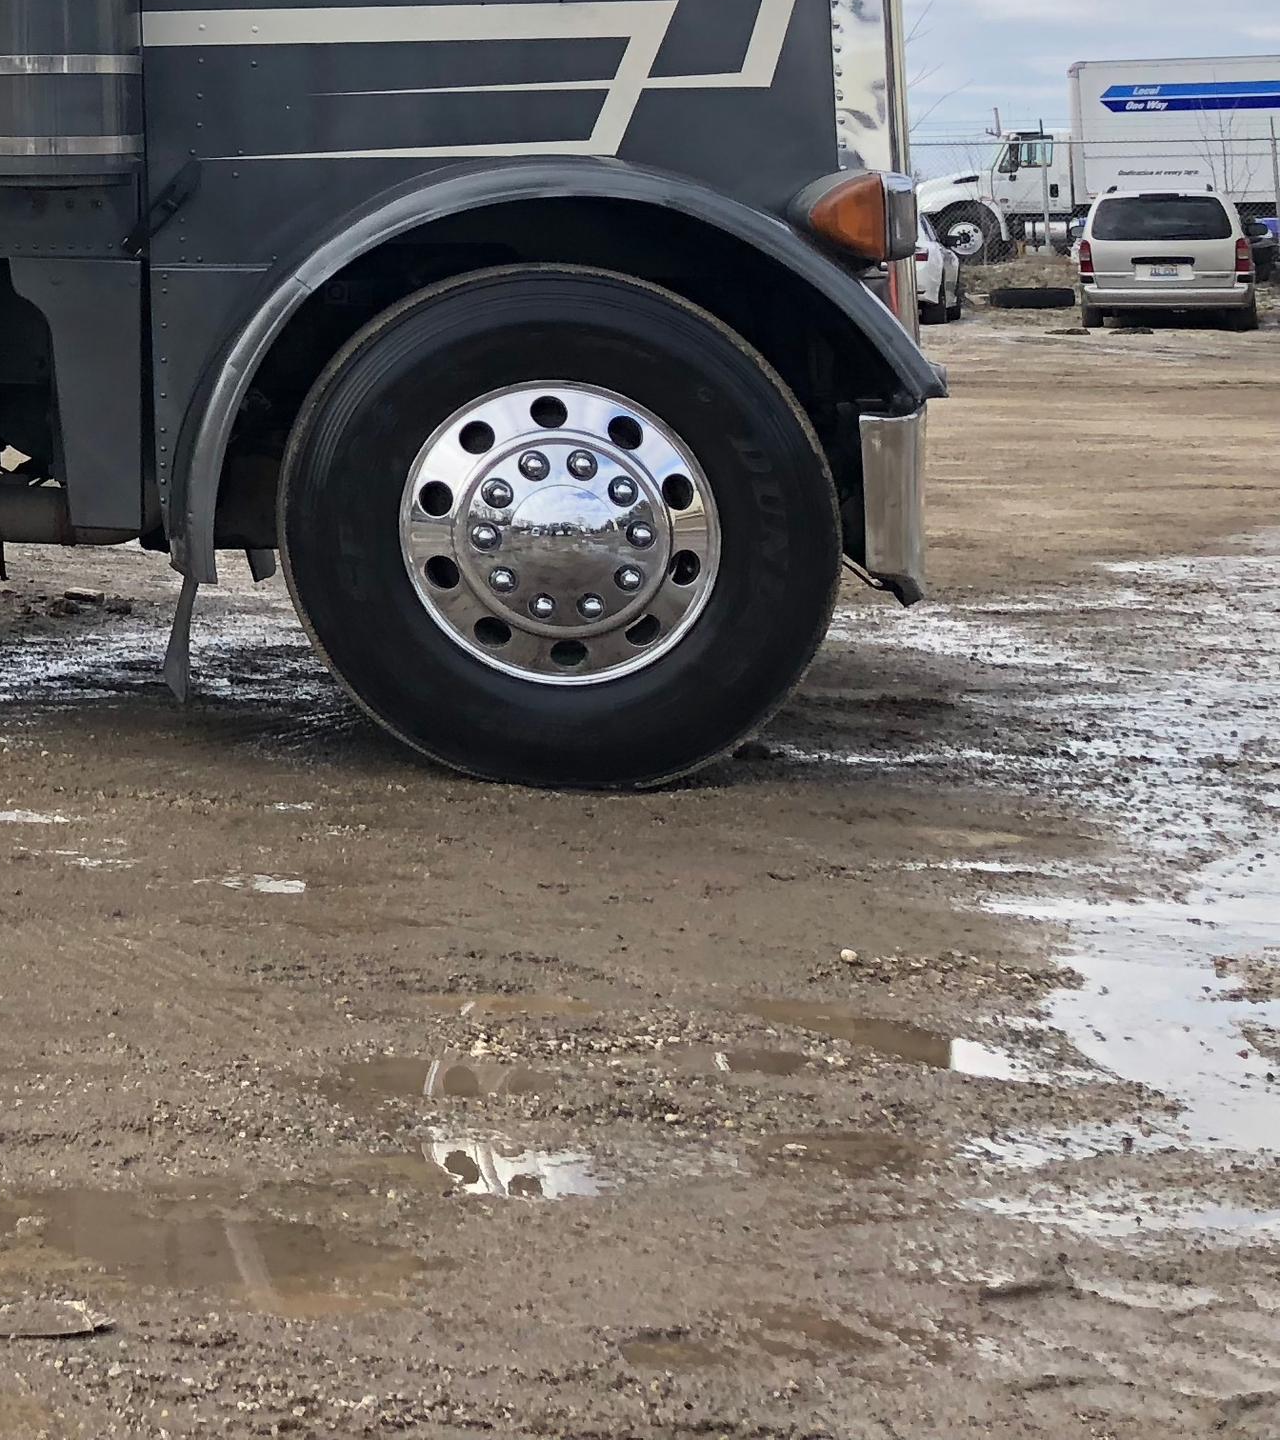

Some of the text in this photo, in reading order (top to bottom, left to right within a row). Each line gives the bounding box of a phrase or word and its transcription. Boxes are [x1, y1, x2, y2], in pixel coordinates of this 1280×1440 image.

[1132, 86, 1161, 96] Local
[1125, 100, 1168, 110] One Way
